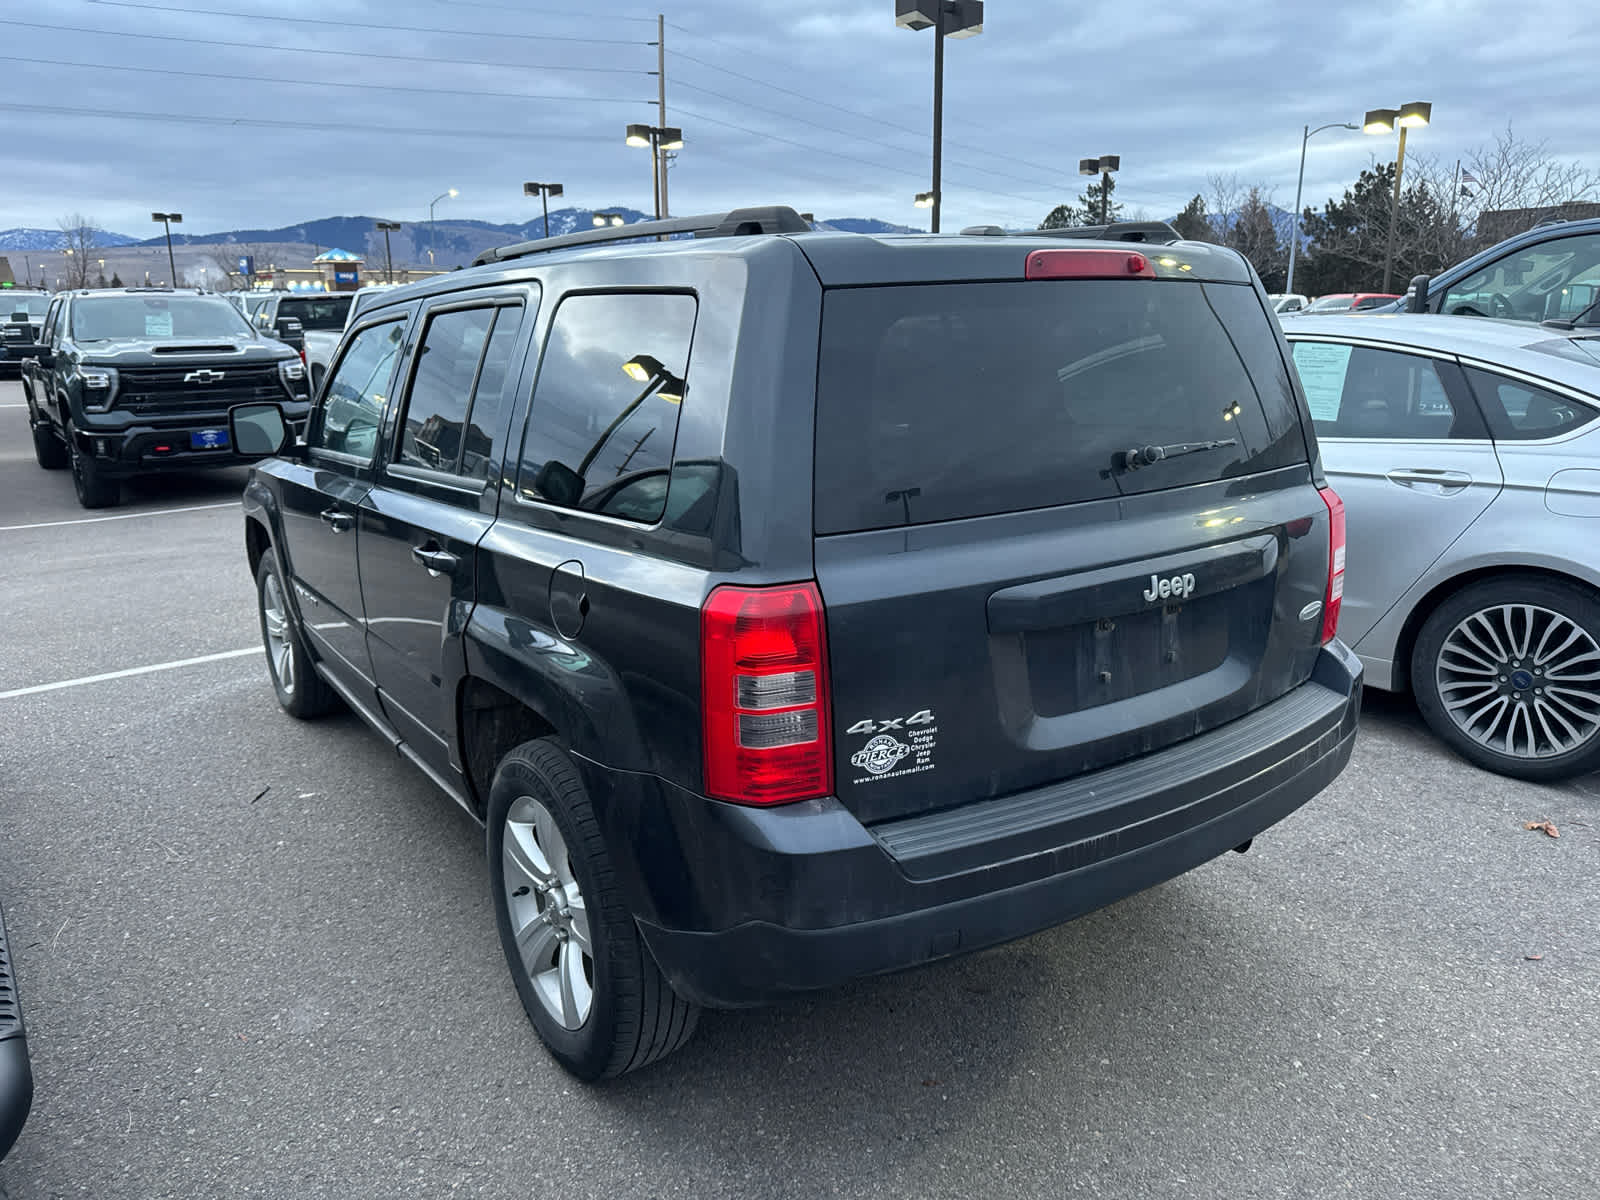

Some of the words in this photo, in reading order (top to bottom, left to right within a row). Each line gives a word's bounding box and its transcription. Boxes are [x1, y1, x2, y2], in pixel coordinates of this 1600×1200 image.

[1143, 573, 1196, 602] Jeep
[909, 727, 938, 737] Chevrolet
[911, 742, 936, 751] Chrysler
[858, 746, 904, 763] PIERCE
